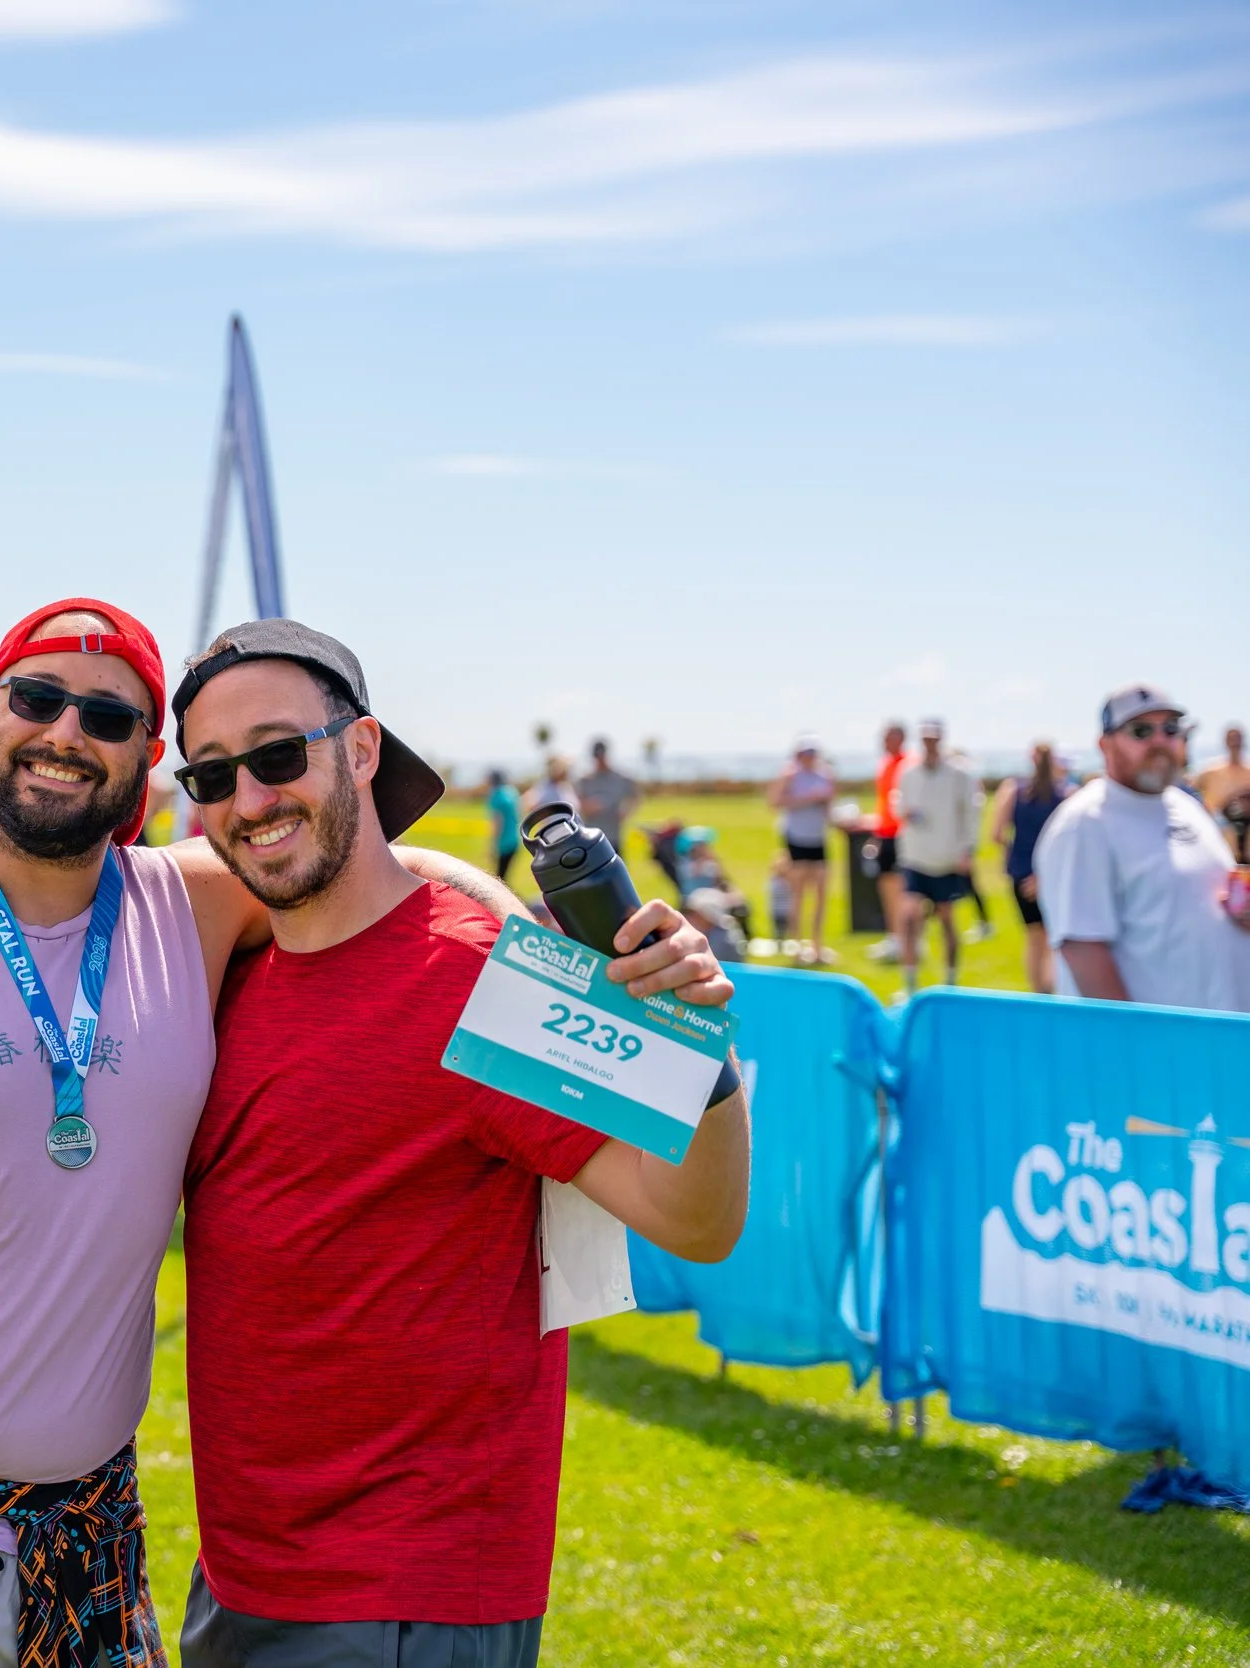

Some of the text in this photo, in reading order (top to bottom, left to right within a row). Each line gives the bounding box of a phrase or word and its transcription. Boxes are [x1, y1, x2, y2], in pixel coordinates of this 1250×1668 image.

[88, 934, 108, 975] 2025
[522, 935, 600, 981] Coastal
[541, 936, 558, 949] The
[10, 956, 41, 996] RUN
[43, 1020, 70, 1061] Coastal
[71, 1016, 88, 1059] Coastal
[540, 1002, 643, 1062] 2239
[545, 1048, 614, 1081] ARIEL HIDALGO
[560, 1083, 585, 1100] 10KM
[54, 1127, 90, 1143] Coastal
[1065, 1119, 1123, 1174] The
